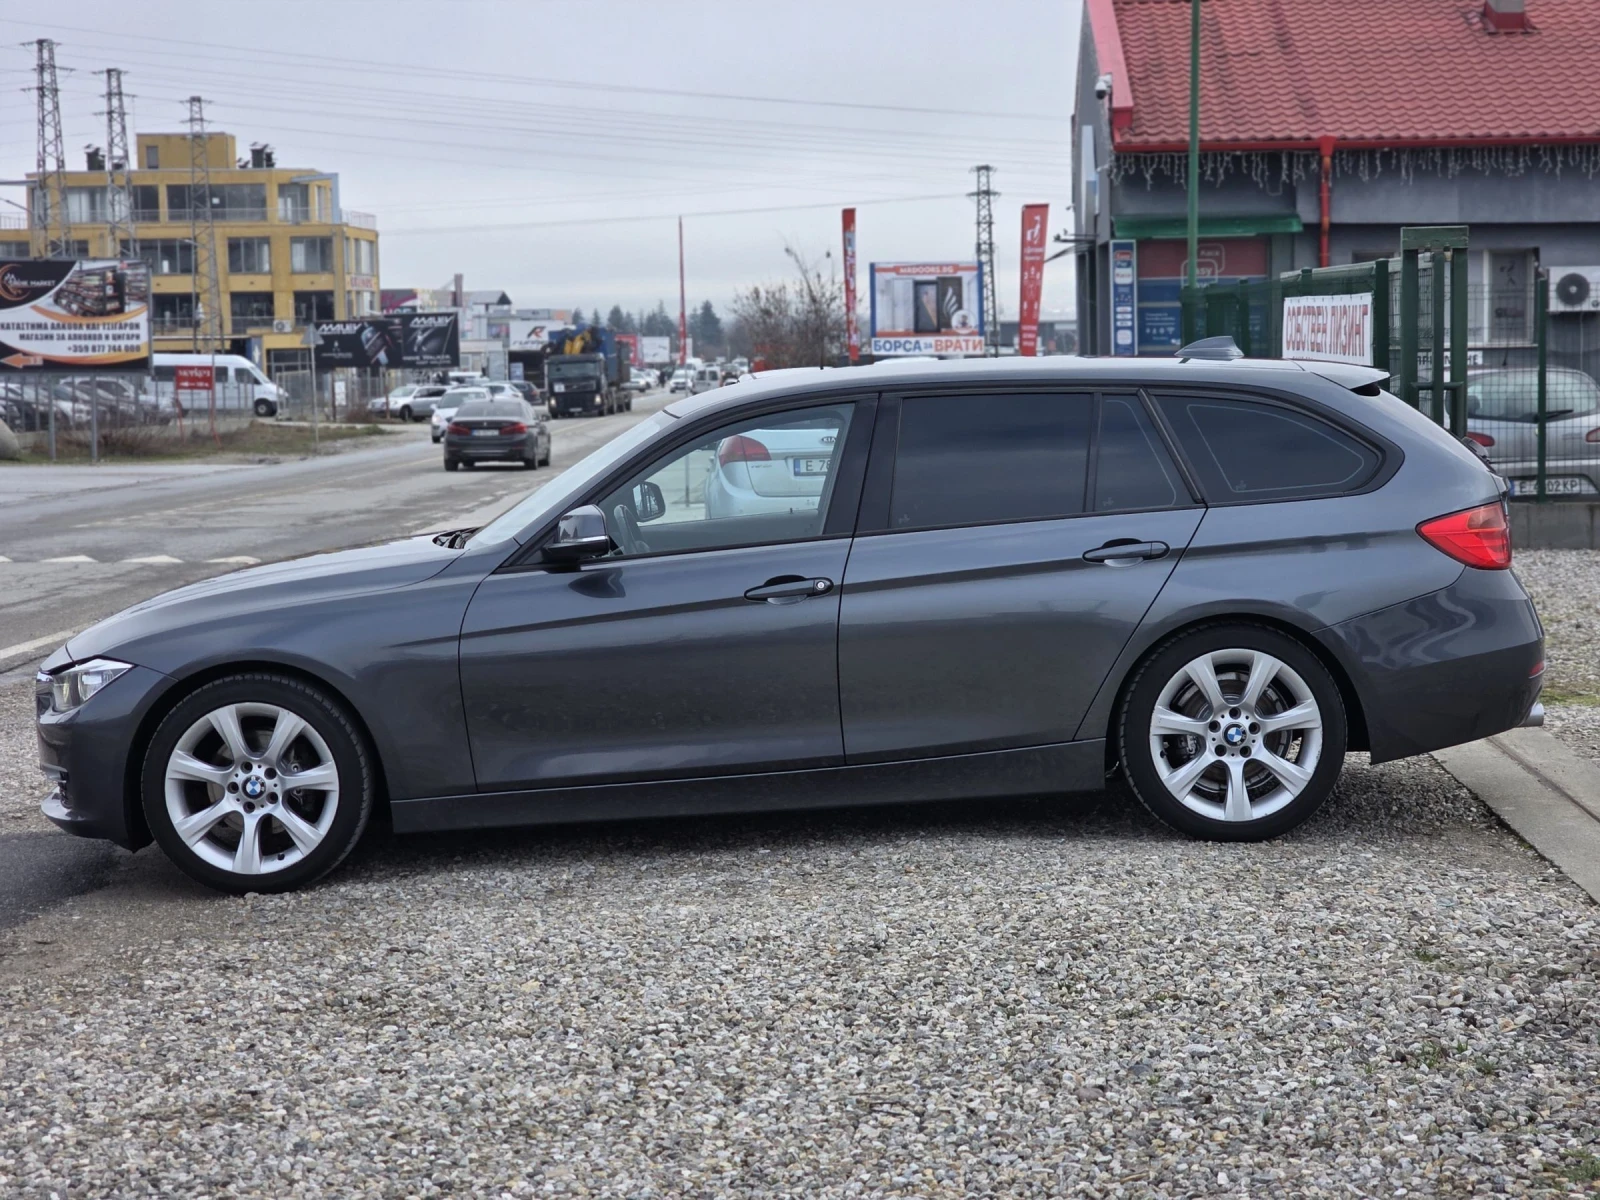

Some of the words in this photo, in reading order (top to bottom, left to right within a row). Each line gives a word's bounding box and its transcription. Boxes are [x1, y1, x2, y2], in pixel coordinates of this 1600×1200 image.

[1286, 305, 1328, 354] СОБСТВЕН
[1329, 304, 1368, 357] ЛИЗИНГ
[873, 340, 922, 352] БОРСА
[934, 339, 983, 352] ВРАТИ
[806, 460, 813, 471] E
